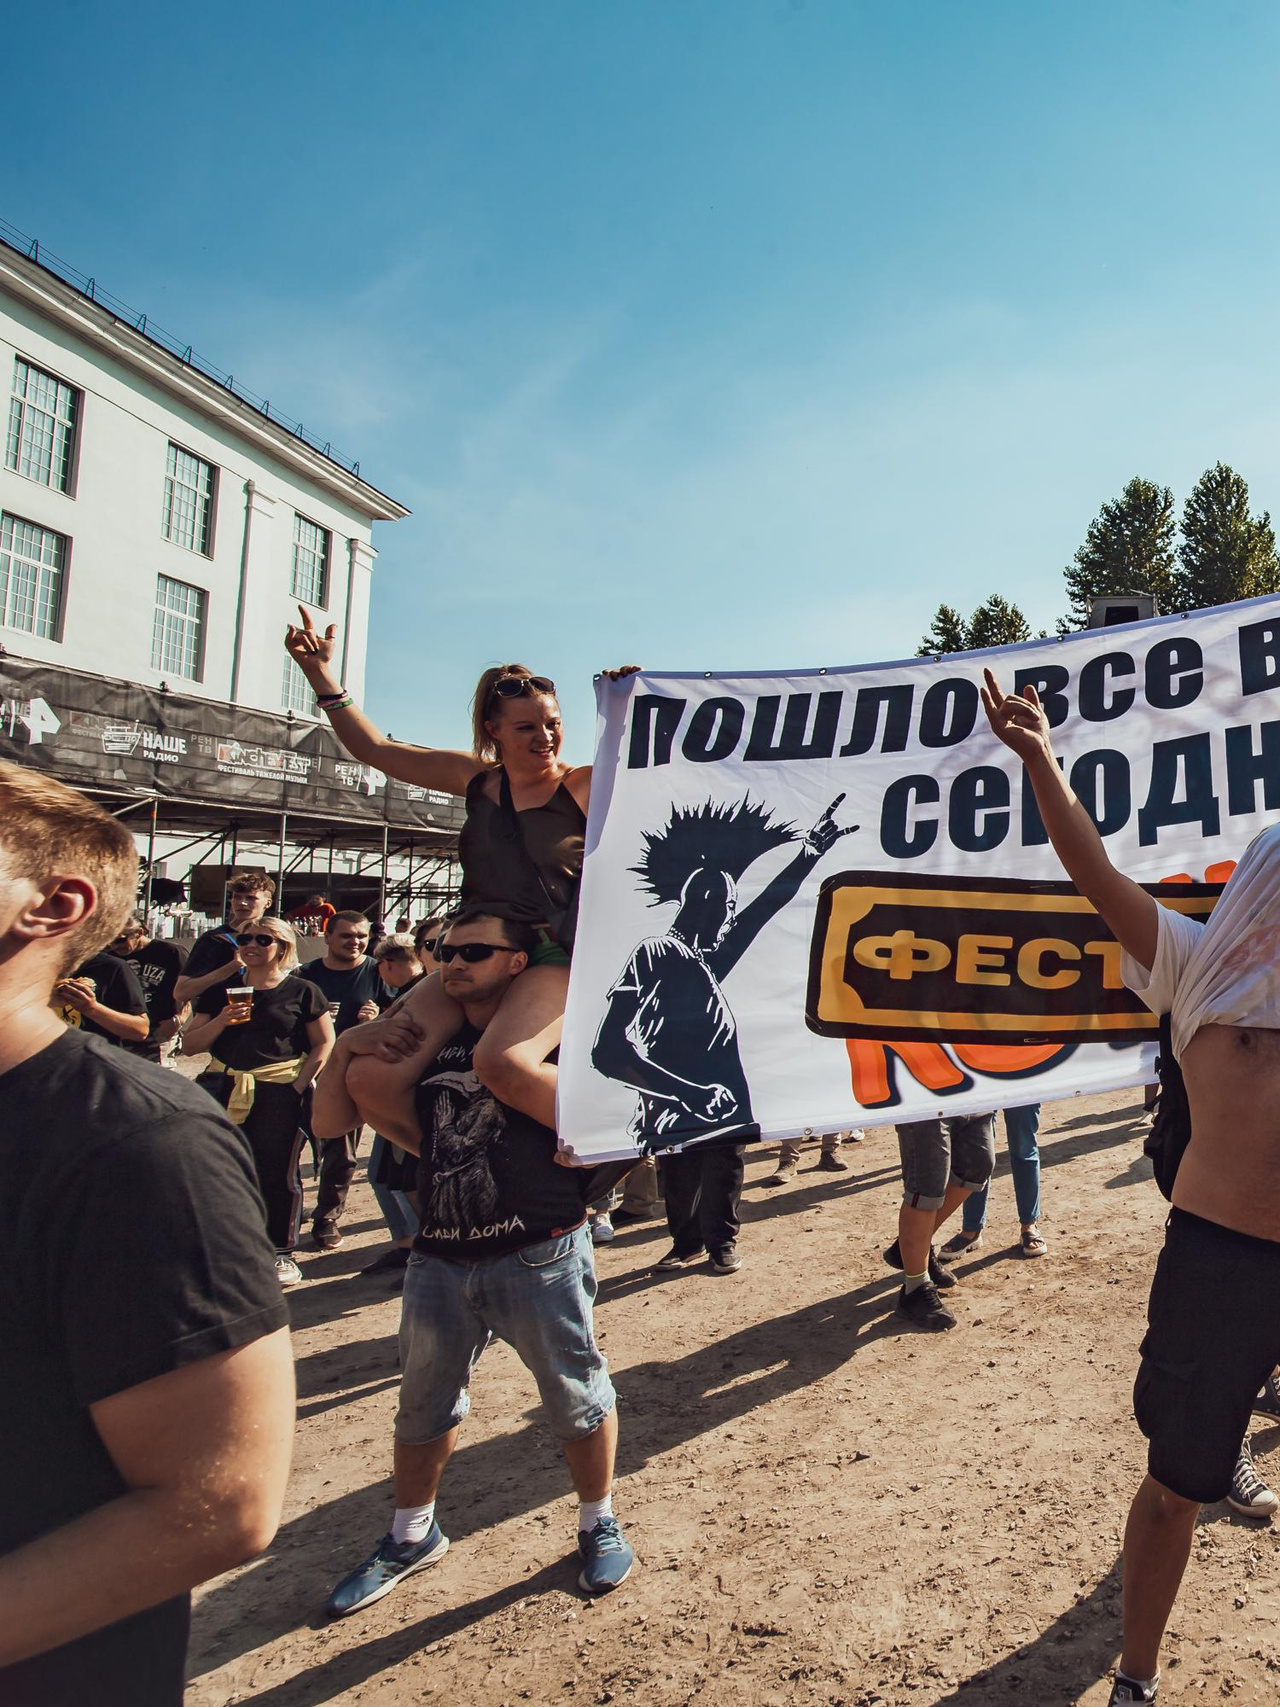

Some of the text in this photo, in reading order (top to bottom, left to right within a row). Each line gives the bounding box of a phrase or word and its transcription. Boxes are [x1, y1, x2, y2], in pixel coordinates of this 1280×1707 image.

[142, 732, 188, 754] НАШЕ
[190, 734, 213, 745] РЕН
[198, 744, 213, 754] ТВ
[143, 750, 179, 763] РАДИО
[217, 764, 255, 776] ФЕСТИВАЛЬ
[334, 764, 357, 776] РЕН
[341, 776, 354, 786] ТВ
